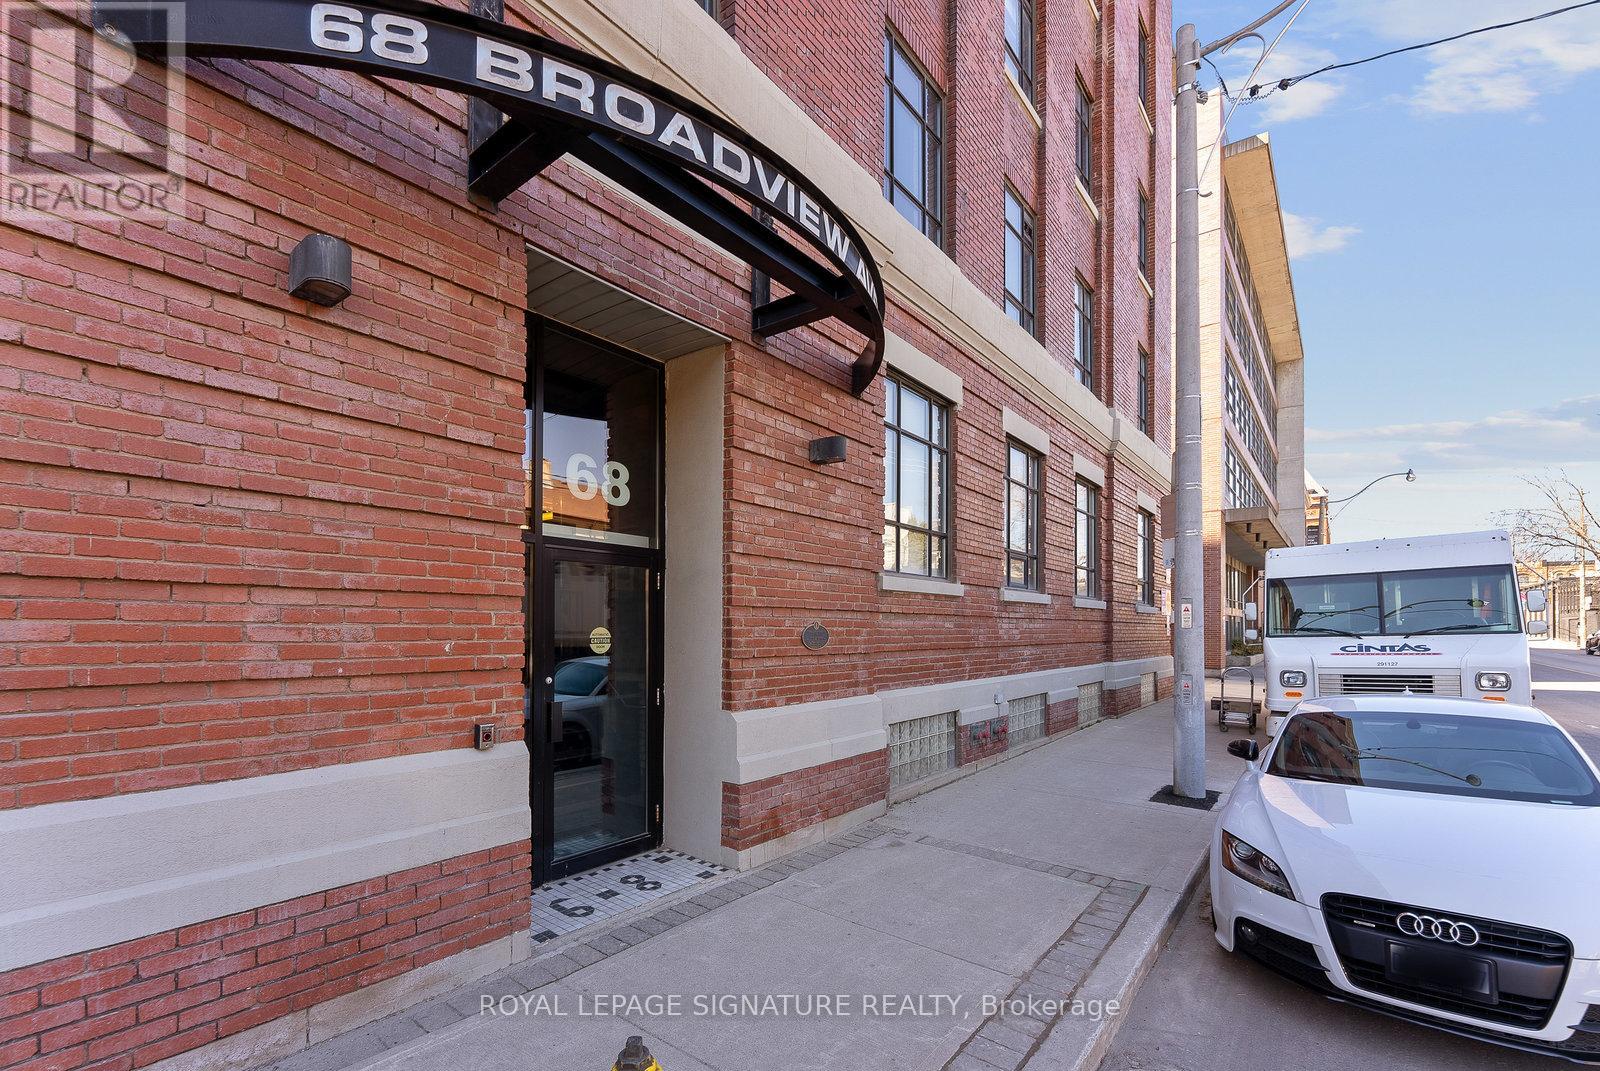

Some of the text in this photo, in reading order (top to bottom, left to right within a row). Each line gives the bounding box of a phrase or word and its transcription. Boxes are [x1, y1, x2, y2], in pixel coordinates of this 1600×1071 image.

[310, 3, 429, 64] 68
[476, 36, 850, 262] BROADVIEW
[566, 453, 631, 507] 68
